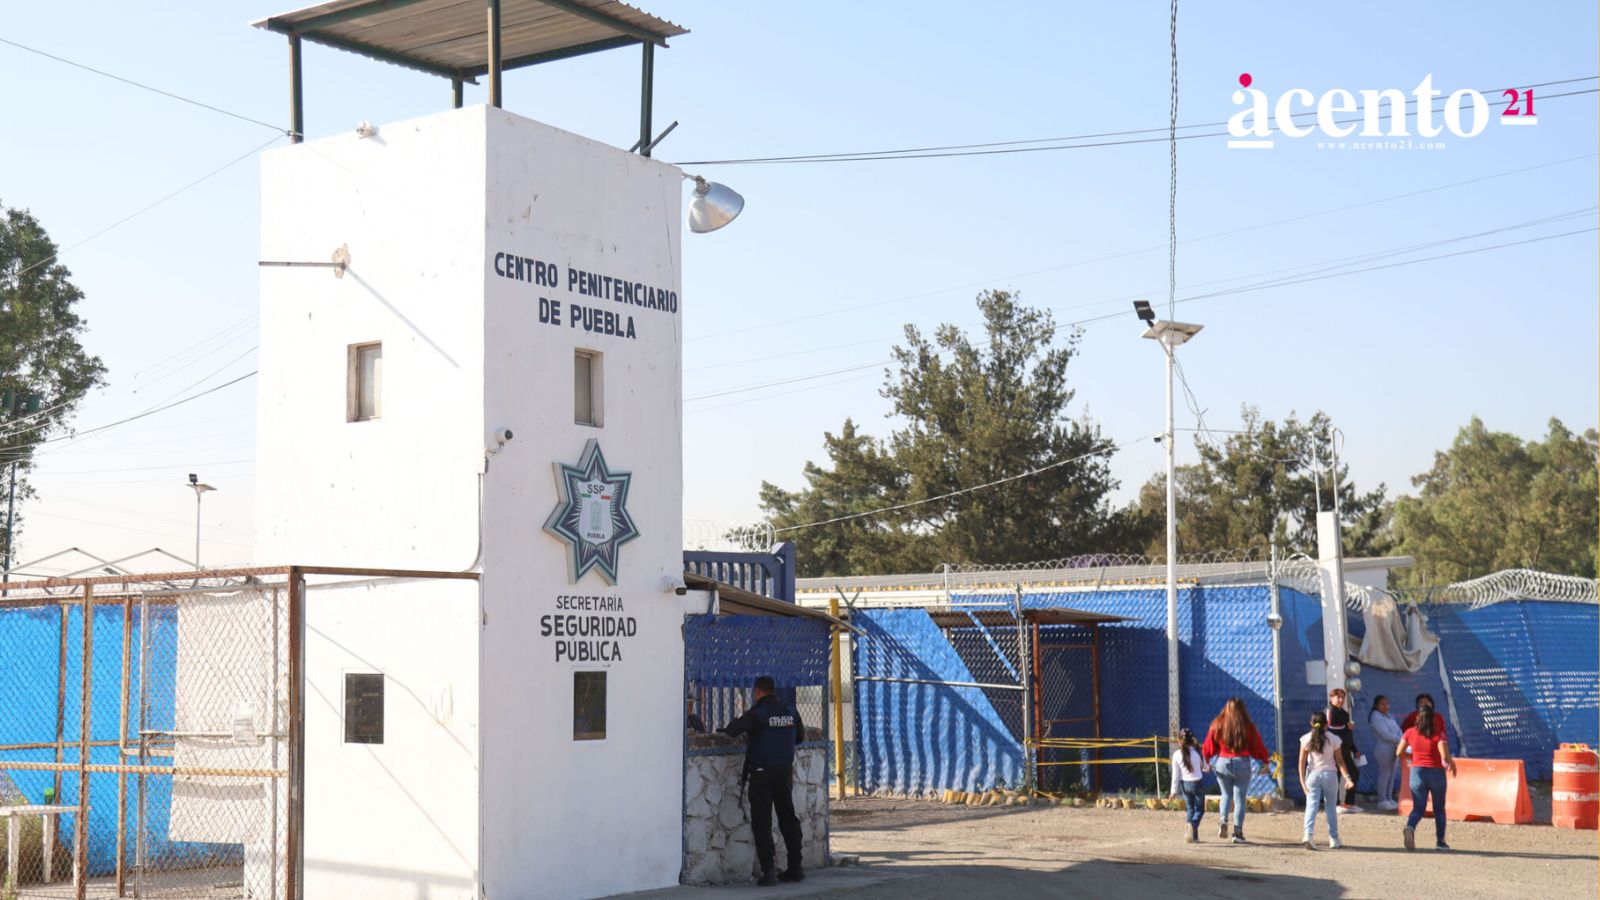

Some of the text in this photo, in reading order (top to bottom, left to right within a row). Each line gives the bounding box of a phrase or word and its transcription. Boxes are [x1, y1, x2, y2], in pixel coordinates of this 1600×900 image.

[494, 252, 677, 314] CENTRO PENITENCIARIO
[539, 297, 636, 339] DE PUEBLA
[587, 484, 605, 494] SSP
[556, 594, 624, 612] SECRETARÍA
[540, 615, 637, 638] SEGURIDAD
[555, 637, 622, 662] PÚBLICA
